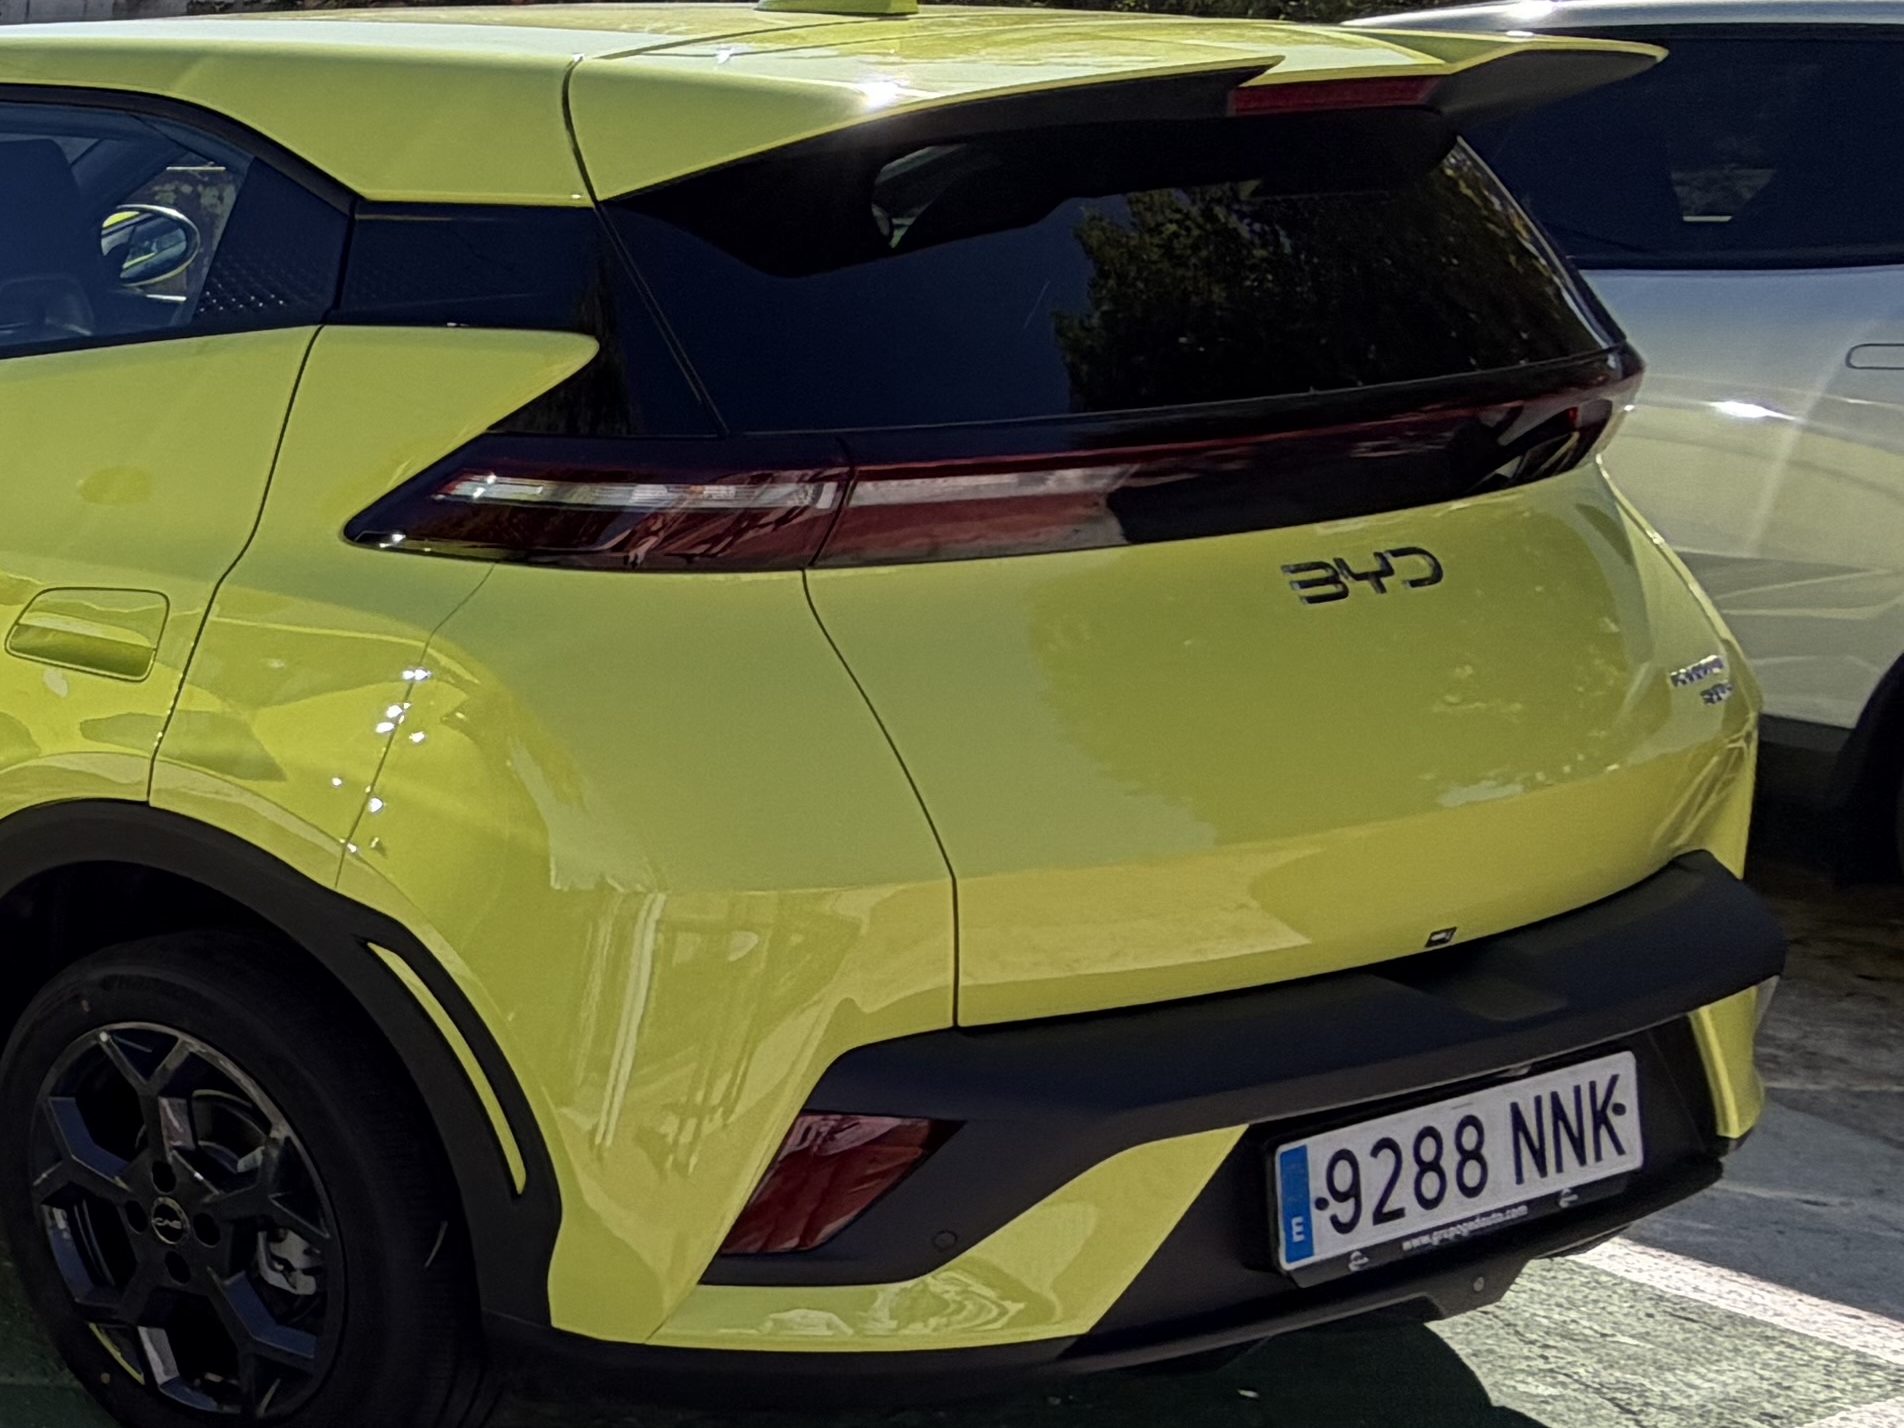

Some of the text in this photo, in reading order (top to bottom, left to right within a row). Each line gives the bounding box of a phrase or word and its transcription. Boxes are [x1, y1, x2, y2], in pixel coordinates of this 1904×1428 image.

[1280, 546, 1444, 605] BYD
[1325, 1073, 1626, 1235] 9288 NNK
[1291, 1216, 1305, 1243] E
